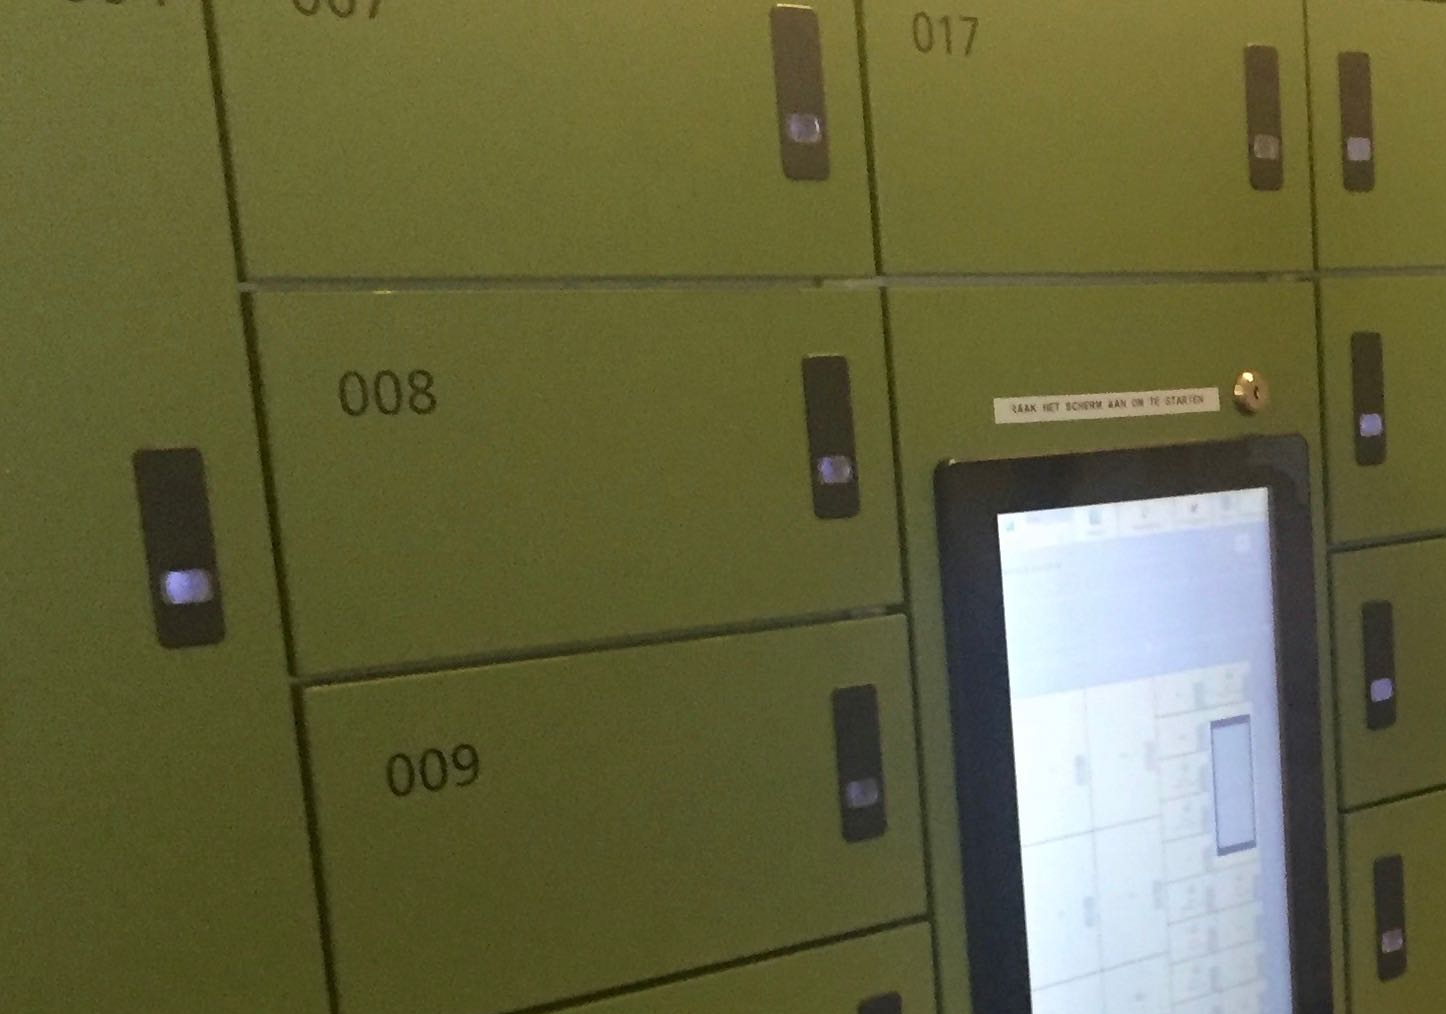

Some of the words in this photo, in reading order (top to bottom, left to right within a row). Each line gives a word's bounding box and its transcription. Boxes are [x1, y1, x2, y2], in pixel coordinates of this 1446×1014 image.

[912, 11, 979, 56] 017
[339, 368, 437, 417] 008
[386, 743, 480, 797] 009
